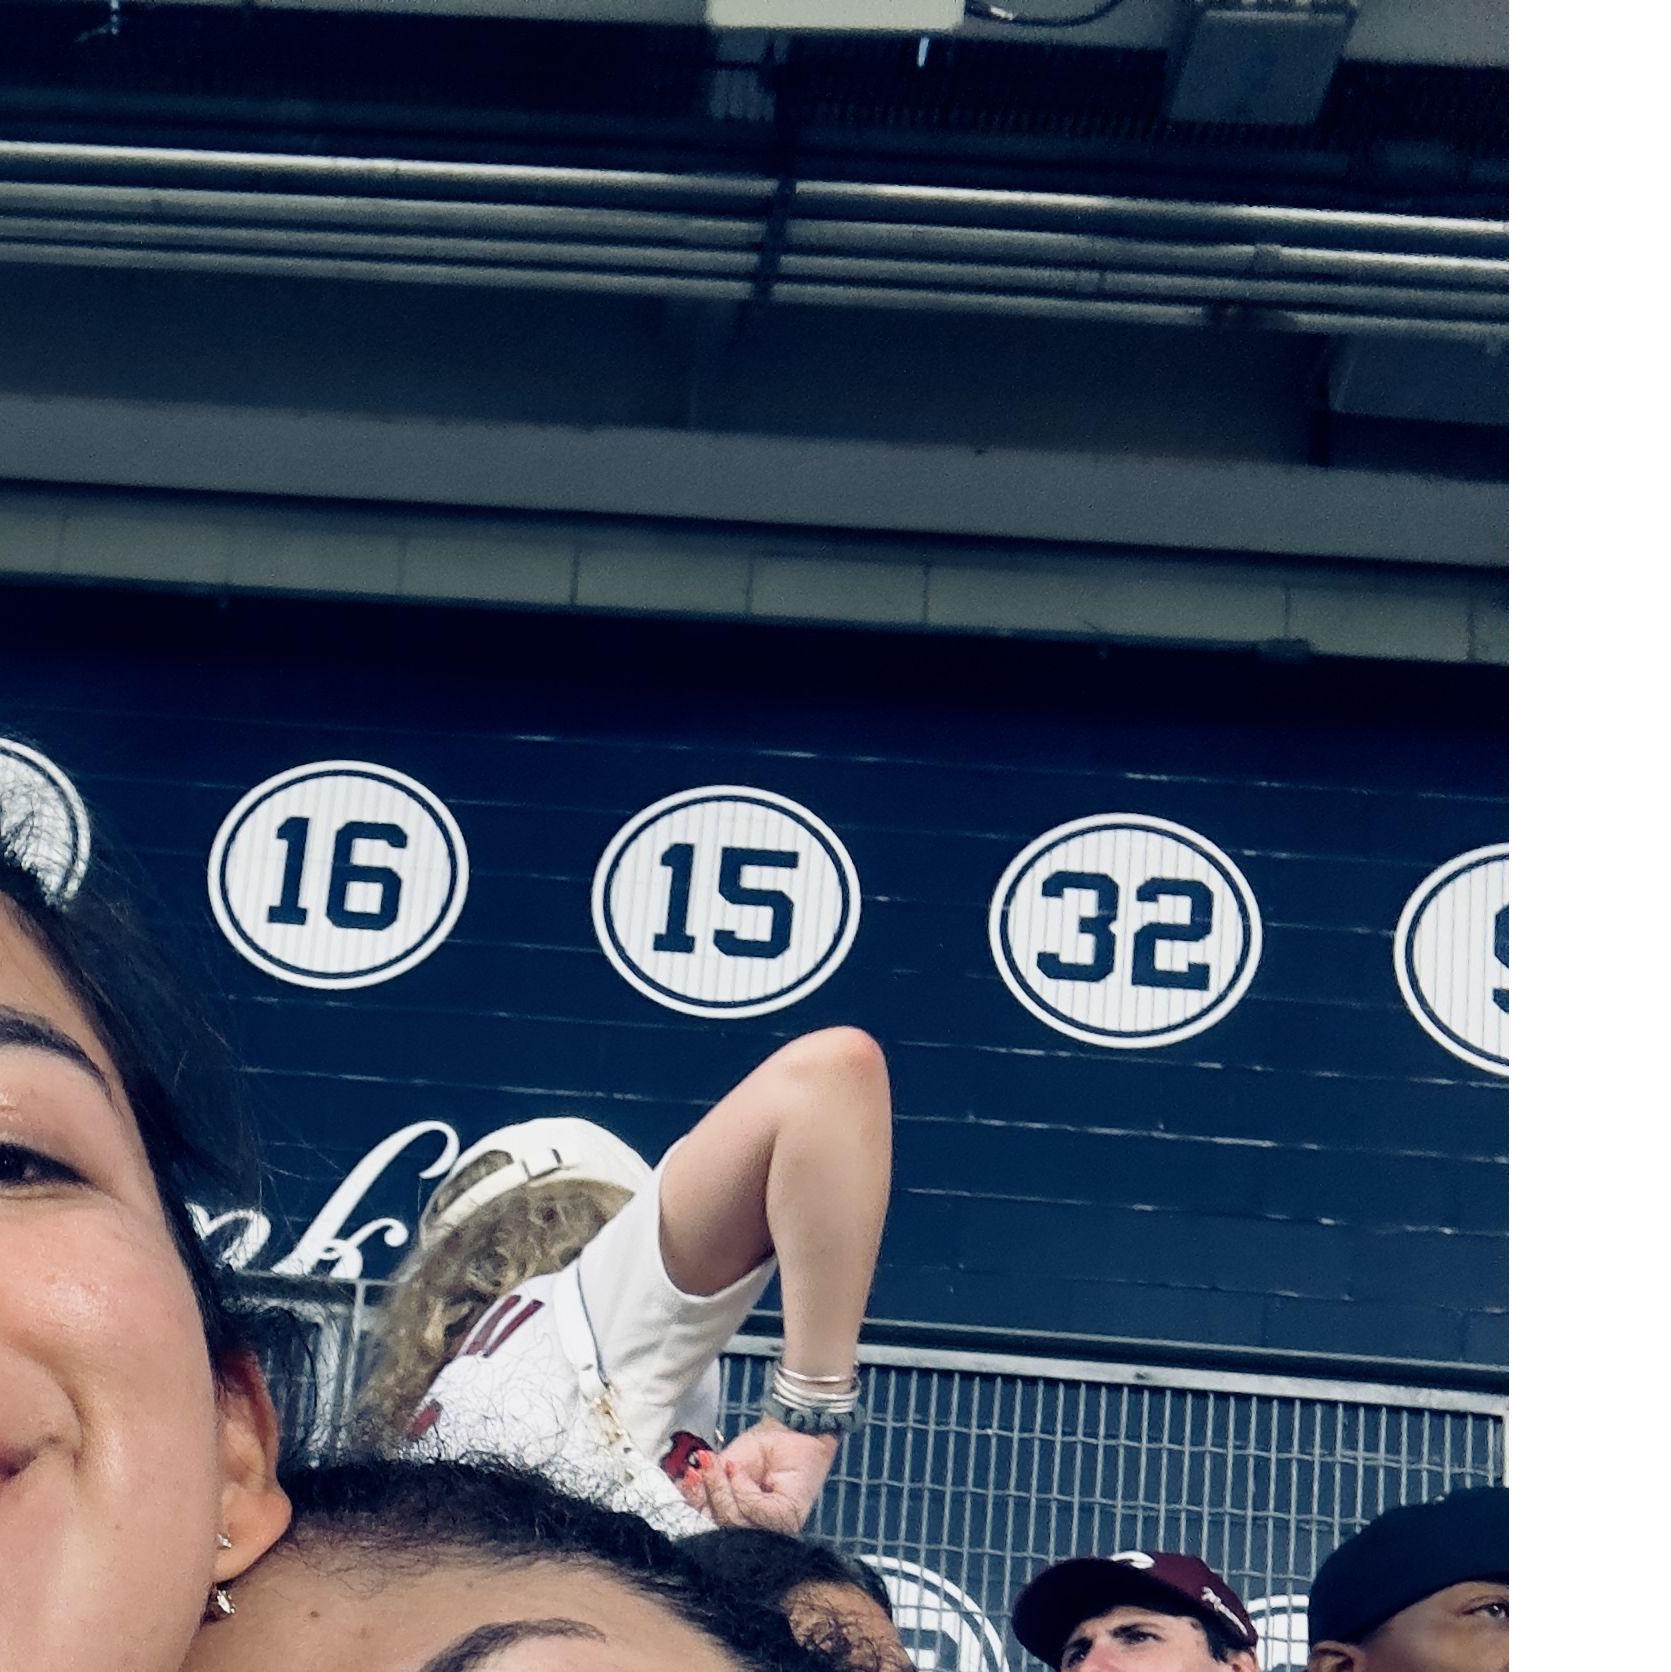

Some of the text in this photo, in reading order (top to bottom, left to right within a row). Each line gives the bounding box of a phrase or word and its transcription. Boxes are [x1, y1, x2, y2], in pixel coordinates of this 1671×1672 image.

[268, 817, 407, 930] 16
[653, 843, 798, 958] 15
[1037, 871, 1213, 991] 32
